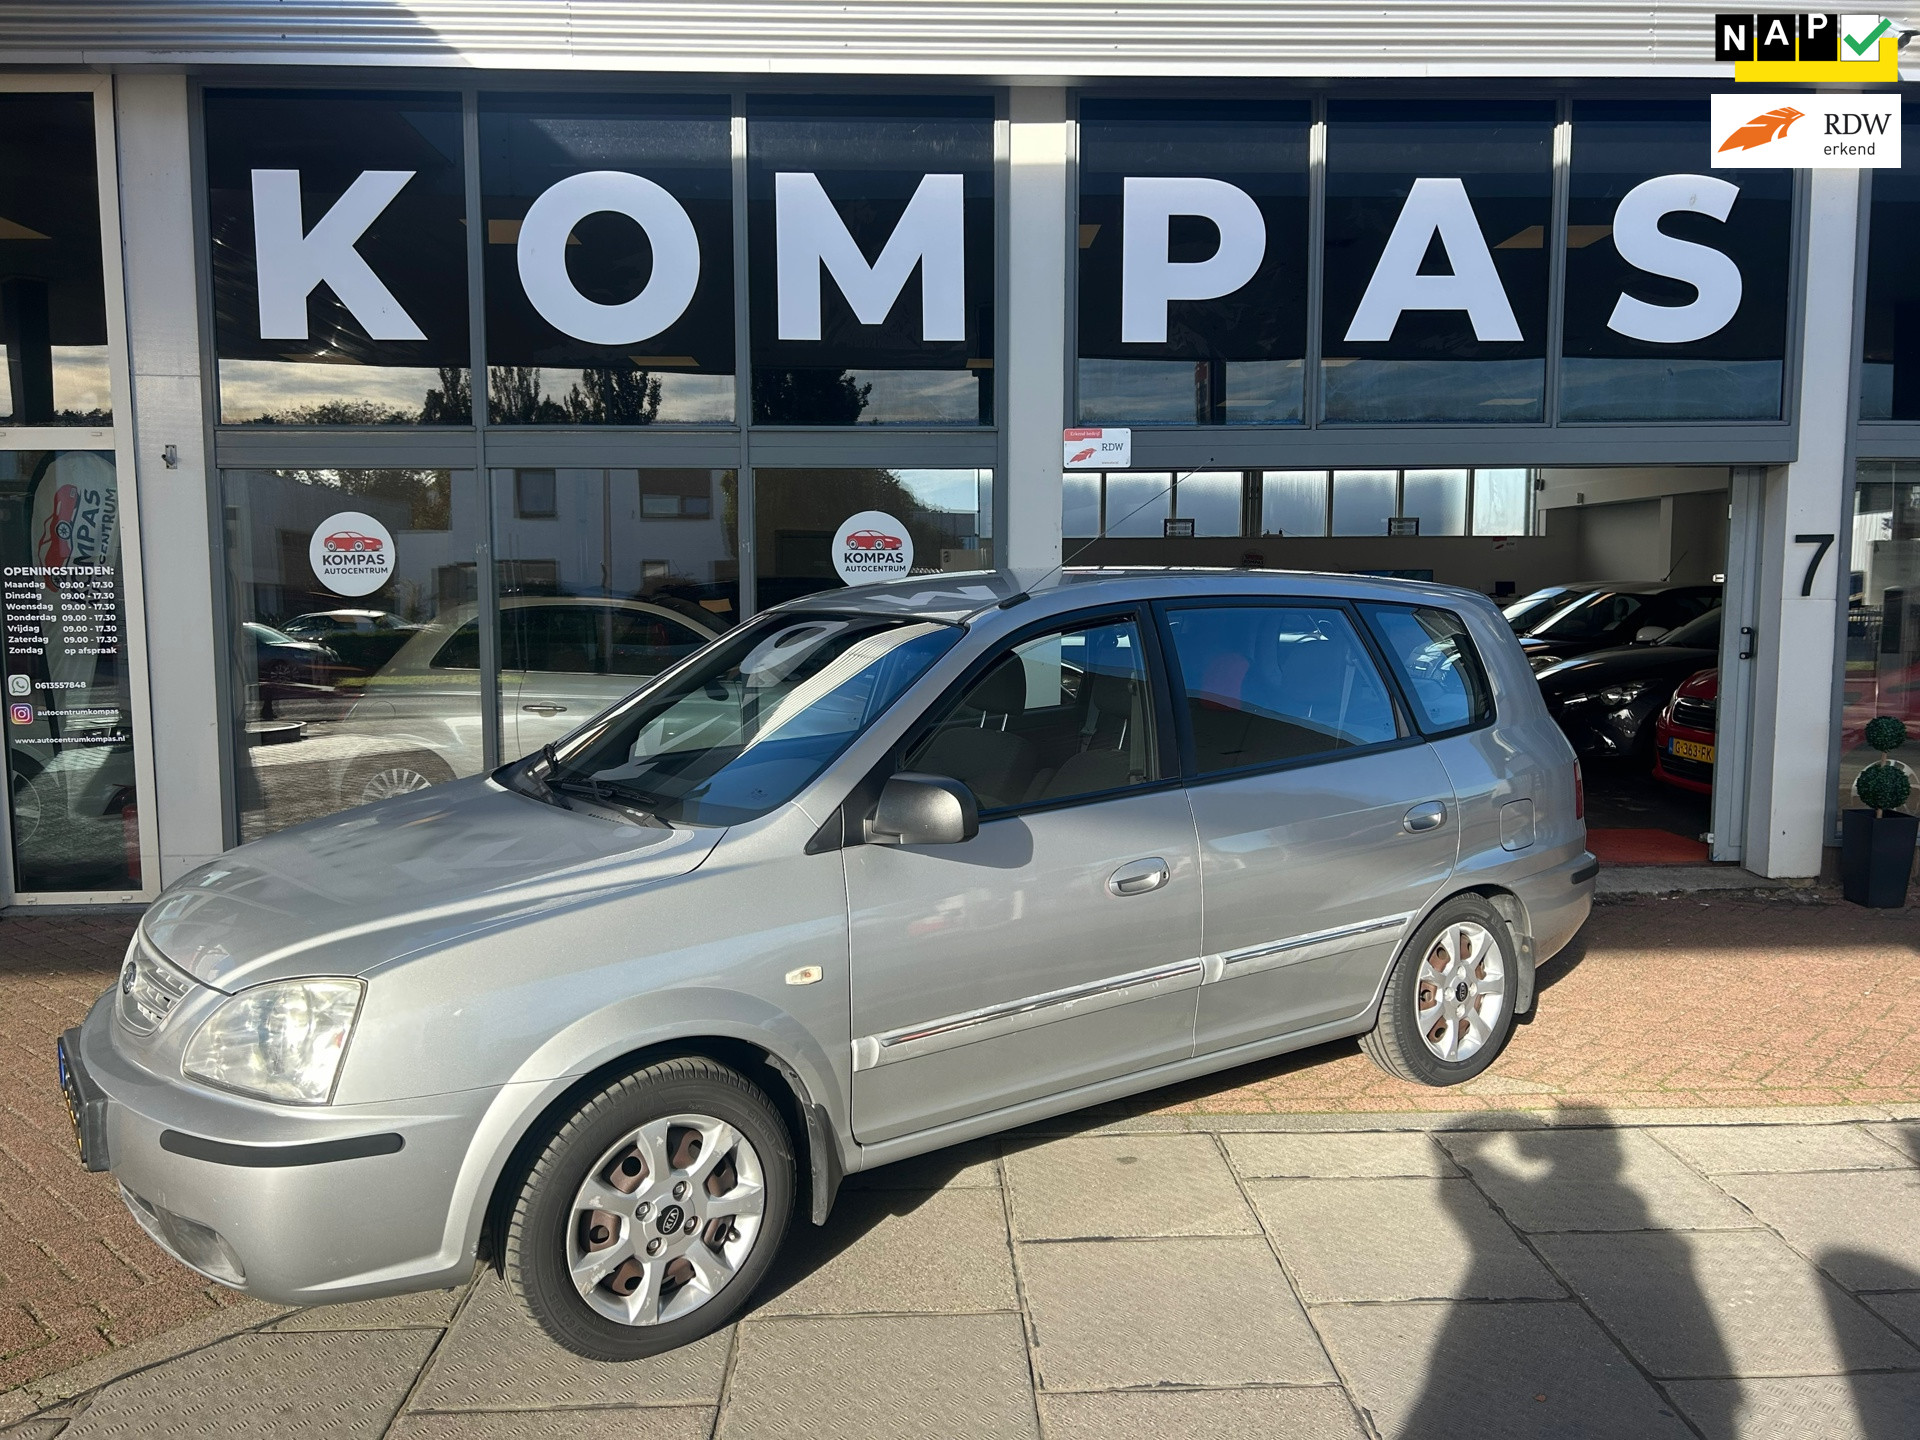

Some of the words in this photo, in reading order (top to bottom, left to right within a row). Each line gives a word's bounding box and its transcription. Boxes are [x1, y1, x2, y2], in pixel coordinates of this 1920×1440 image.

[251, 169, 1742, 345] KOMPAS
[1101, 443, 1124, 451] RDW
[322, 554, 385, 566] KOMPAS
[844, 552, 904, 563] KOMPAS
[1795, 533, 1835, 597] 7
[3, 566, 115, 576] OPENINGSTIJDEN:
[324, 567, 388, 575] AUTOCENTRUM
[4, 581, 46, 589] Maandag
[60, 581, 85, 589] 09.00
[92, 581, 114, 589] 17.30
[5, 592, 42, 600] Dinsdag
[61, 592, 86, 600] 09.00
[93, 592, 115, 600] 17.30
[6, 603, 54, 611] Woensdag
[61, 603, 86, 611] 09.00
[93, 603, 115, 611] 17.30
[7, 614, 57, 622] Donderdag
[62, 614, 87, 622] 09.00
[94, 614, 116, 622] 17.30
[7, 625, 40, 633] Vrijdag
[63, 625, 88, 633] 09.00
[95, 625, 117, 633] 17.30
[8, 636, 49, 644] Zaterdag
[64, 636, 88, 644] 09.00
[95, 636, 118, 644] 17.30
[9, 647, 43, 655] Zondag
[78, 647, 117, 655] afspraak
[35, 681, 87, 689] 0613557848
[37, 709, 119, 717] autocentrumkompas
[15, 735, 125, 744] www.autocentrumkompas.nl
[665, 1212, 677, 1229] KIA
